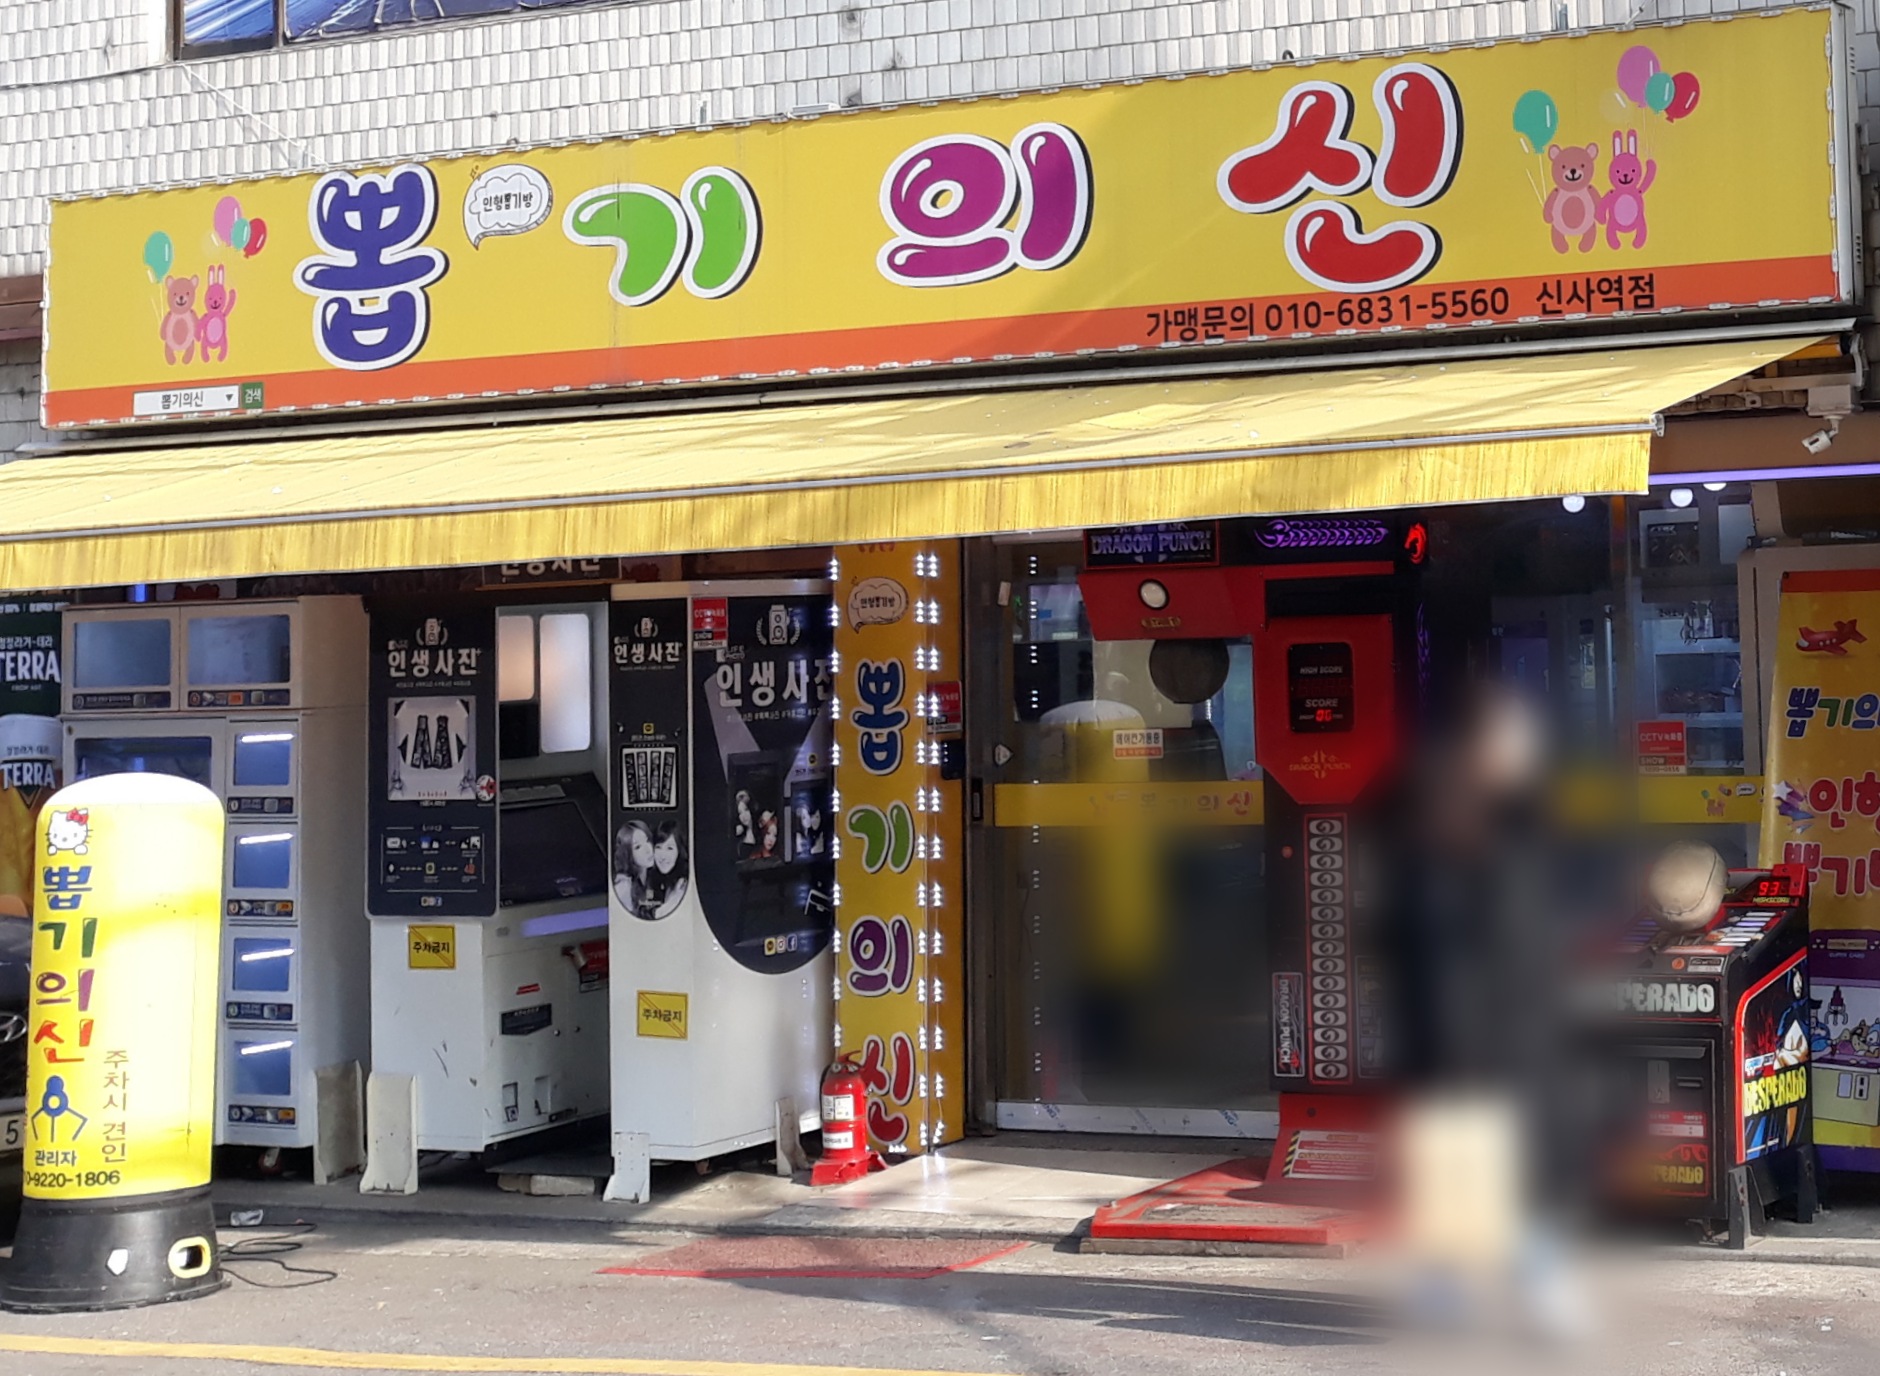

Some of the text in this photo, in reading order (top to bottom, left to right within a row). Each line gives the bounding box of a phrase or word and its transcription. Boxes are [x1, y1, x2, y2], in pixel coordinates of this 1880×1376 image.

[482, 191, 533, 213] 인형뽑기방
[1146, 273, 1656, 343] 가맹문의 010-6831-5560 신사역점
[161, 391, 204, 409] 뽑기의신
[244, 388, 262, 403] 검색
[1090, 530, 1212, 555] DRAGON PUNCH
[1305, 699, 1339, 707] SCORE
[0, 761, 56, 790] TERRA
[1758, 881, 1781, 896] 93
[412, 940, 451, 955] 주차금지
[641, 1007, 683, 1024] 주차금지
[1279, 1026, 1291, 1065] PUNCH
[1743, 1065, 1807, 1117] DESPERADO
[101, 1121, 127, 1163] 견인
[35, 1149, 77, 1167] 관리자
